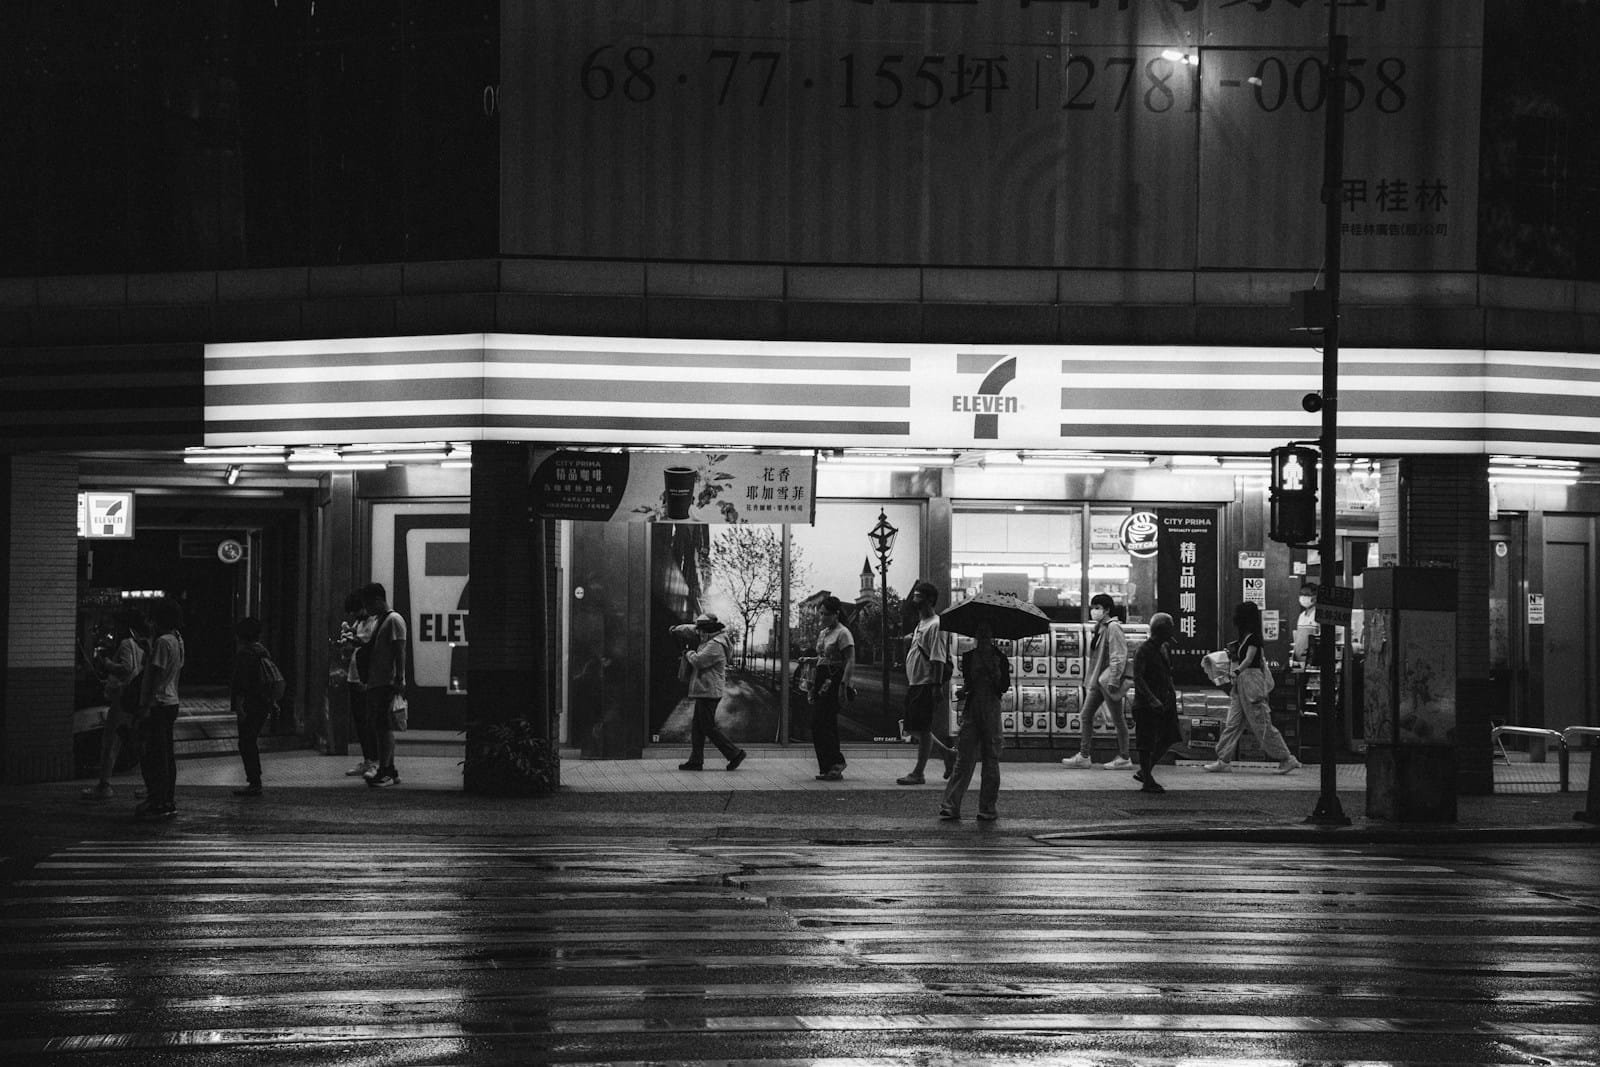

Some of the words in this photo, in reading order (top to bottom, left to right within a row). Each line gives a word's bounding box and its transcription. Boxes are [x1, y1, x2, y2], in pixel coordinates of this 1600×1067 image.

[1341, 178, 1448, 212] 甲桂林
[762, 467, 790, 482] 花香
[746, 485, 805, 501] 耶加雪菲
[1163, 518, 1182, 526] CITY
[1184, 518, 1211, 526] PRIMA
[1247, 559, 1263, 567] 127
[1179, 541, 1197, 638] 精品咖啡
